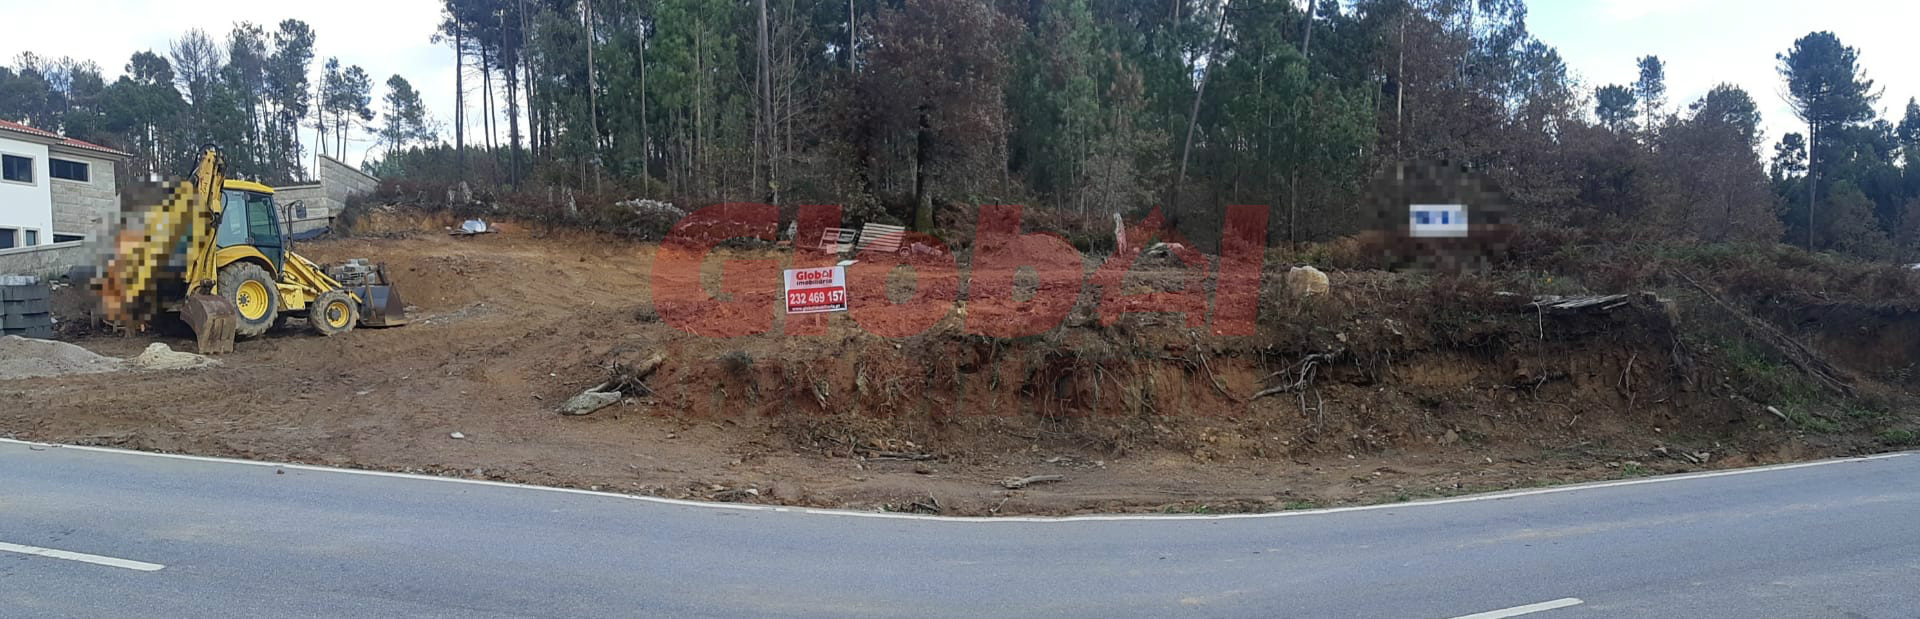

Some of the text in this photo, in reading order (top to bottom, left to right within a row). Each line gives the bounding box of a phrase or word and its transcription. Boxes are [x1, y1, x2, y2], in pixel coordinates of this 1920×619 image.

[790, 290, 844, 305] 232 469 157
